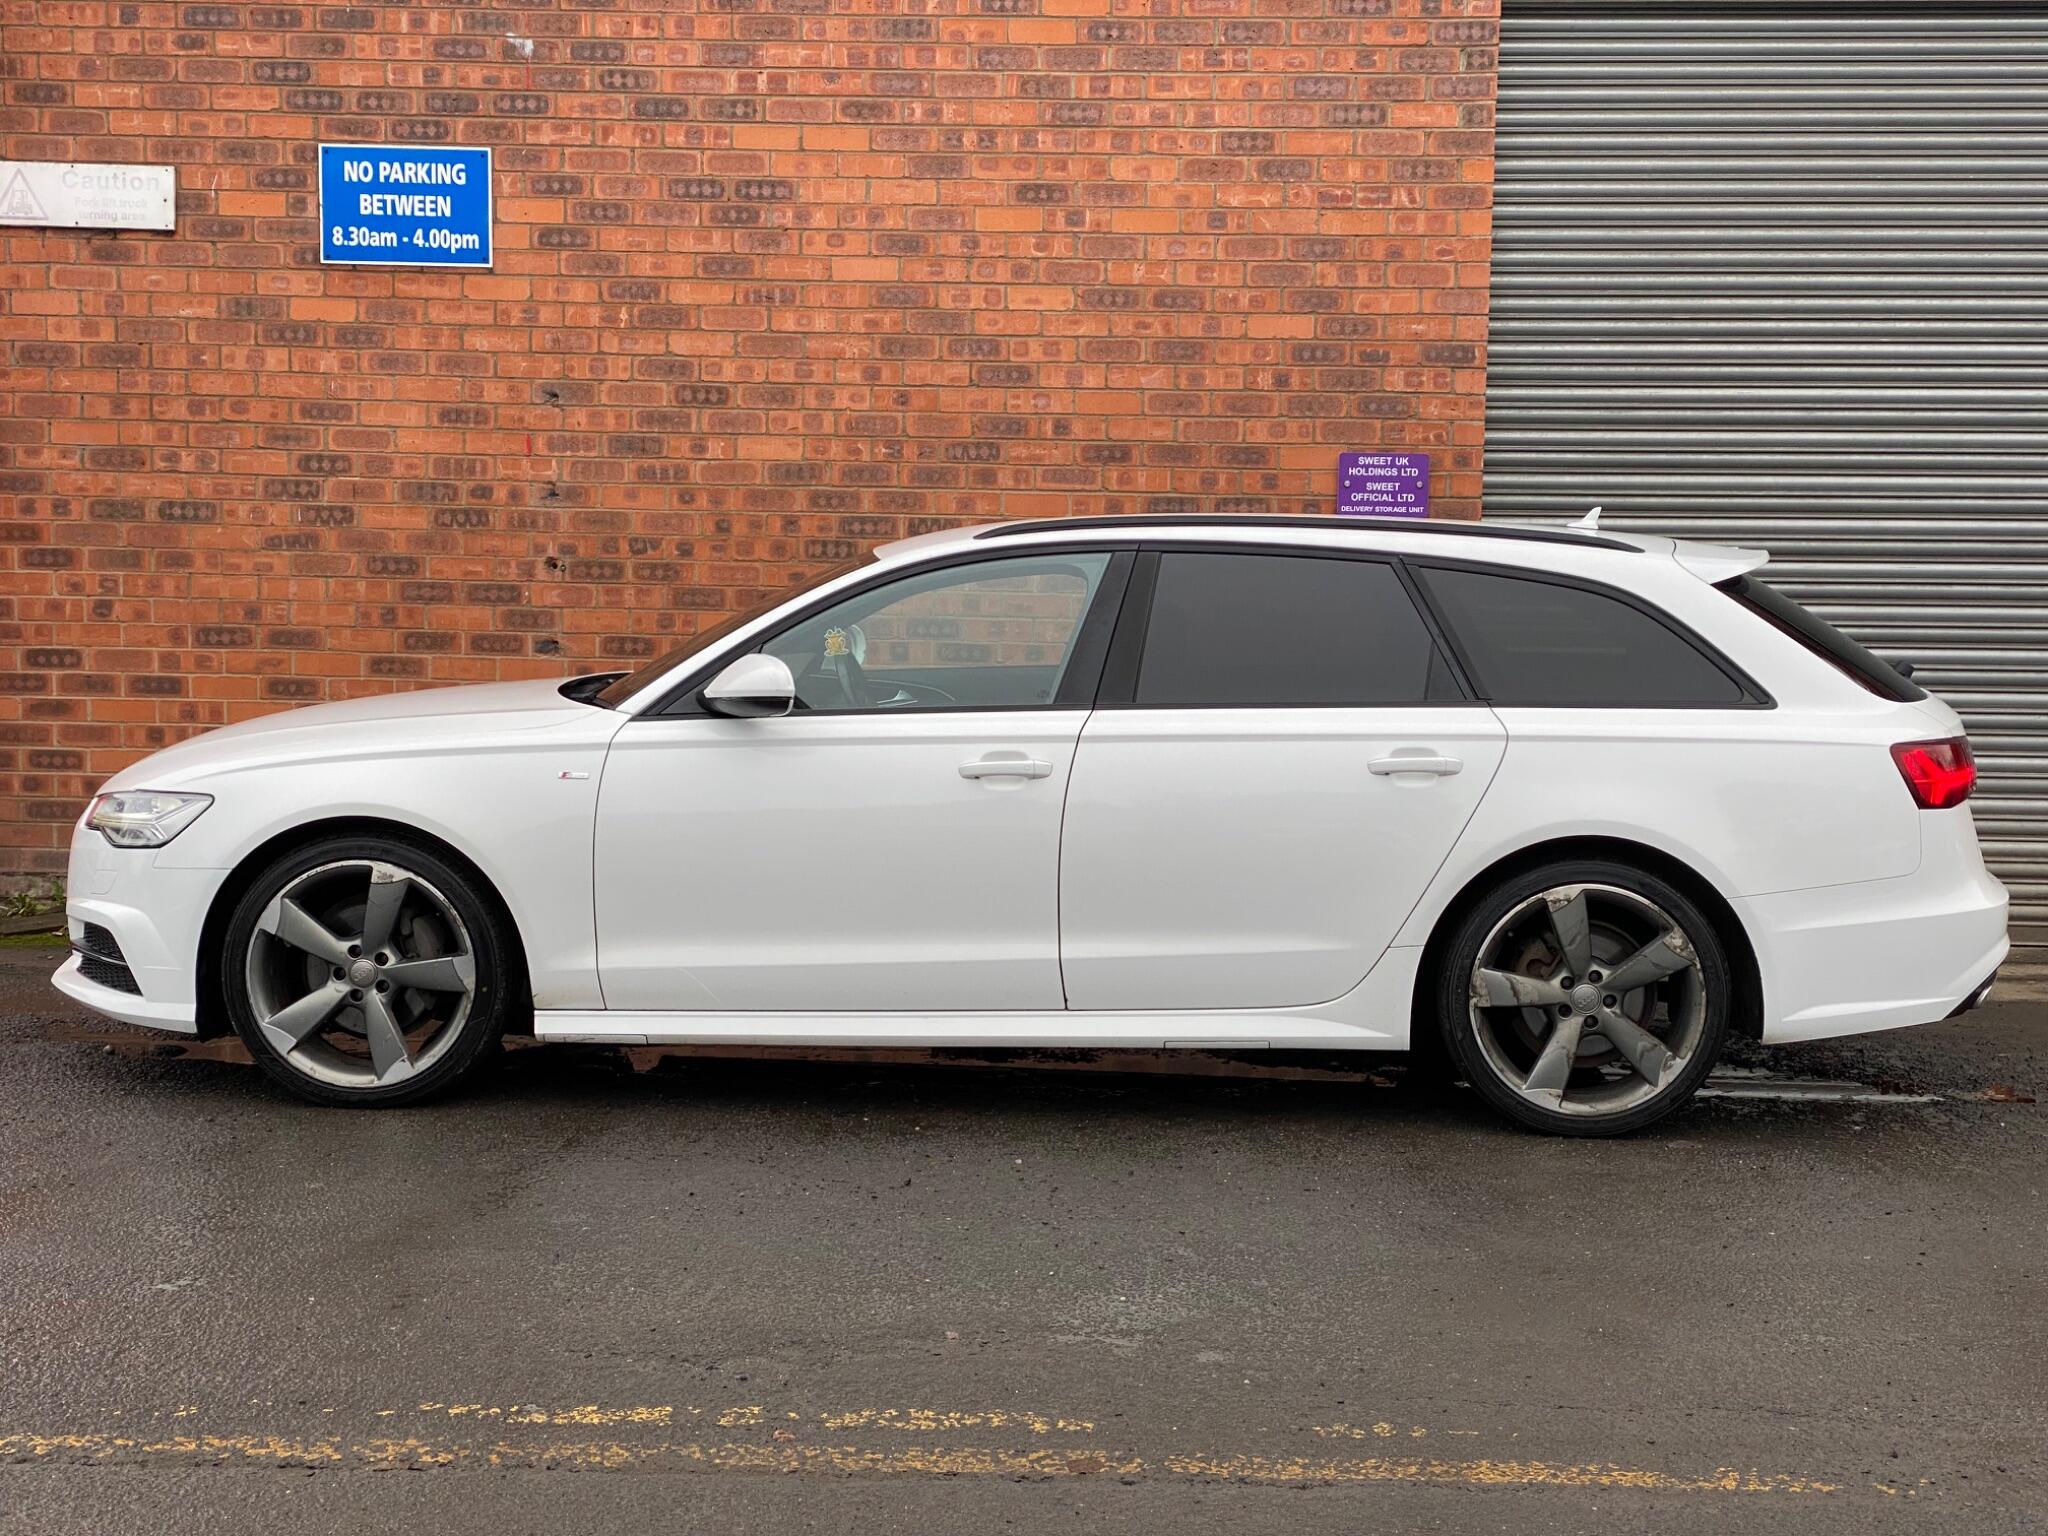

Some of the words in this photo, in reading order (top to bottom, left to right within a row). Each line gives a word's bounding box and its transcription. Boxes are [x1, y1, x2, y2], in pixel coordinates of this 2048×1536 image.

[343, 161, 373, 182] NO
[379, 161, 467, 185] PARKING
[62, 170, 160, 192] Caution
[359, 193, 451, 217] BETWEEN
[332, 226, 397, 247] 8.30am
[413, 228, 480, 253] 4.00pm
[1358, 457, 1392, 465] SWEET
[1395, 457, 1409, 465] UK
[1348, 467, 1398, 476] HOLDINGS
[1401, 468, 1419, 476] LTD
[1366, 482, 1400, 491] SWEET
[1351, 493, 1394, 502] OFFICIAL
[1397, 494, 1415, 502] LTD
